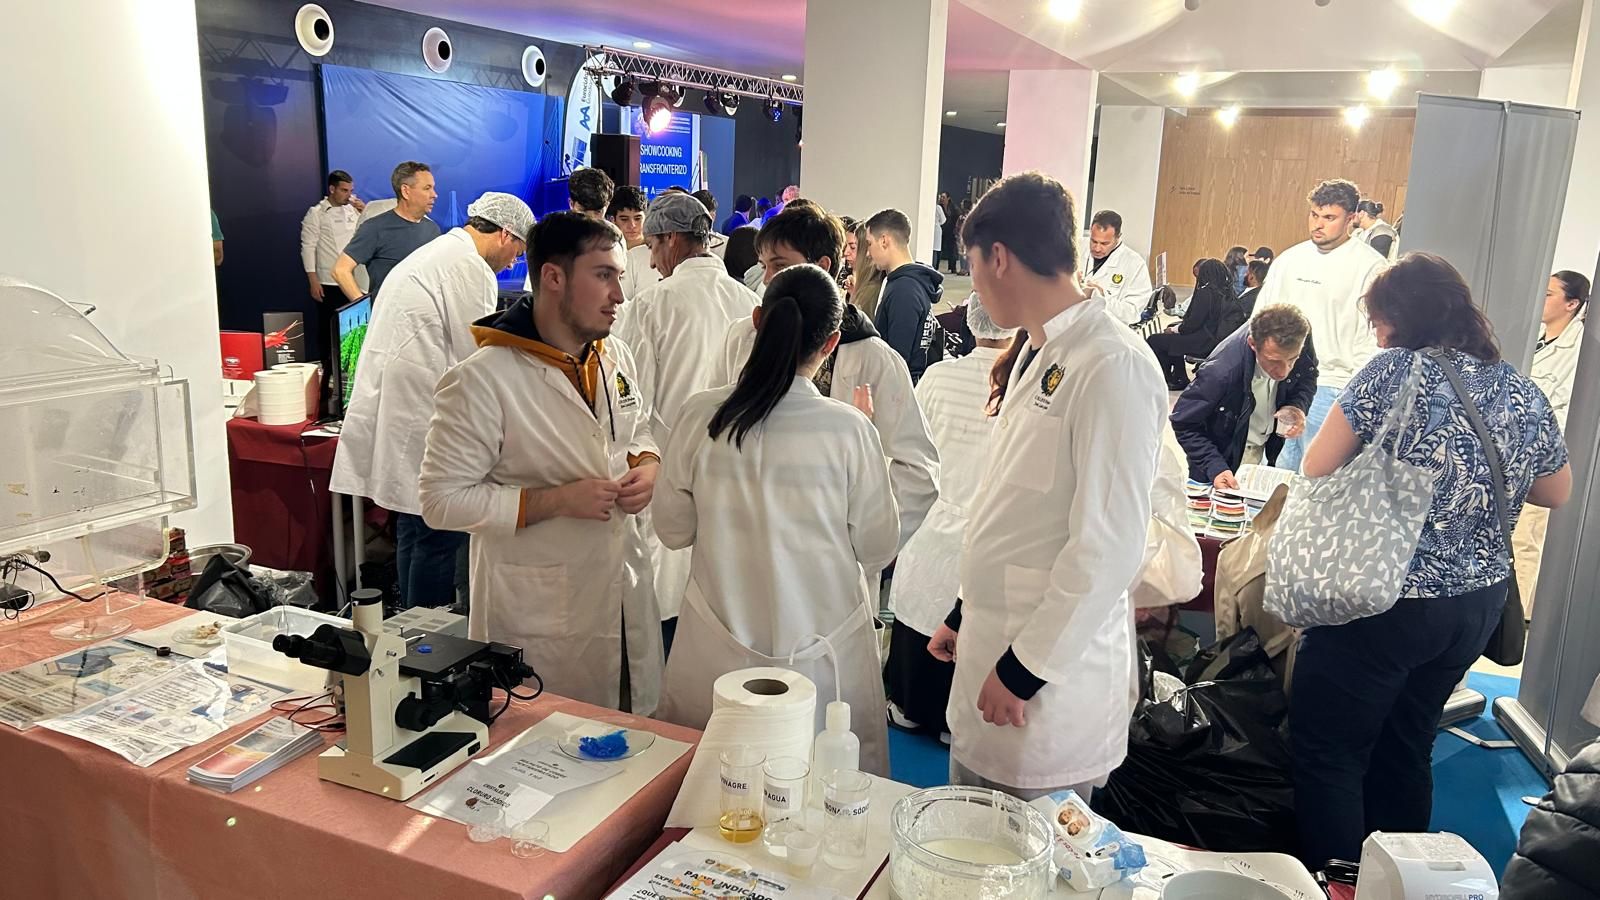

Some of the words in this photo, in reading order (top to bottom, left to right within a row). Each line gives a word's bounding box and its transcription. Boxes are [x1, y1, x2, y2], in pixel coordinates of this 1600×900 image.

[640, 144, 682, 157] SHOWCOOKING
[640, 163, 688, 175] RANSFRONTERIZO
[721, 776, 748, 790] VINAGRE
[466, 786, 491, 799] CLORURO
[767, 792, 787, 803] AGUA
[718, 881, 773, 900] INDICAD
